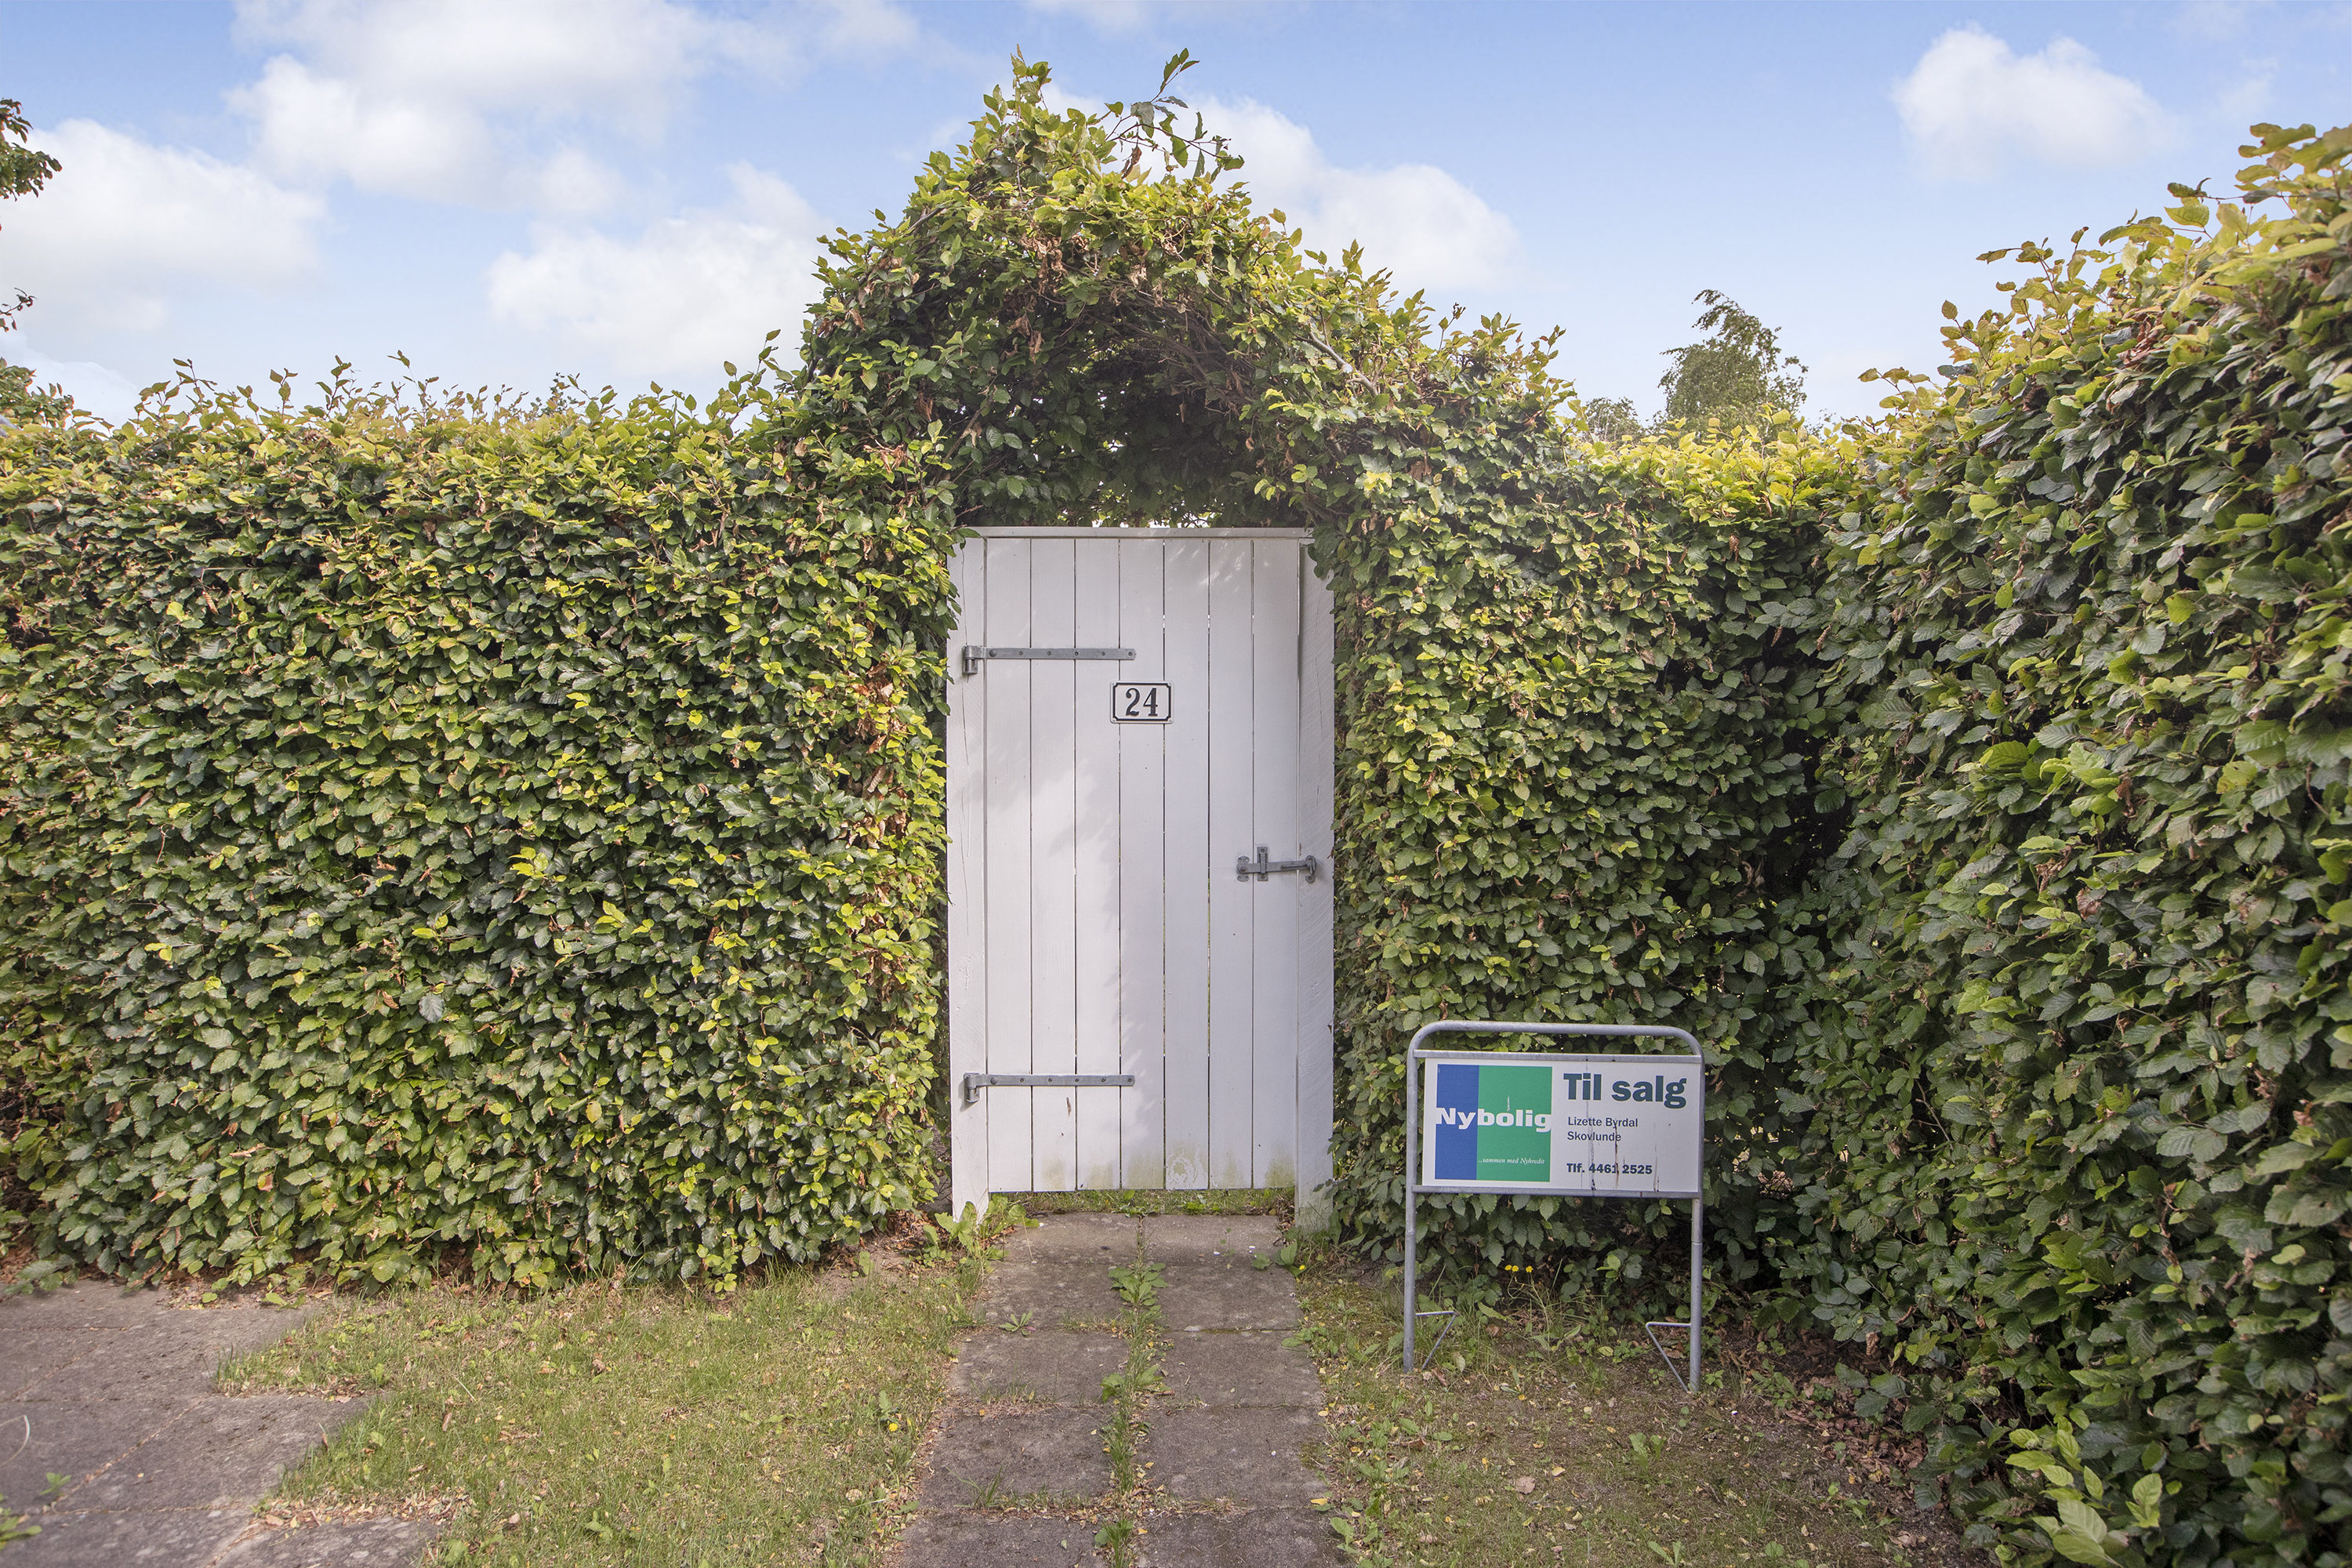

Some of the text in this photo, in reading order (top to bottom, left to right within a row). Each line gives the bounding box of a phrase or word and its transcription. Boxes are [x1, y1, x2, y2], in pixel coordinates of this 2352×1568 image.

[1126, 688, 1158, 717] 24
[1563, 1073, 1687, 1109] Til salg
[1436, 1107, 1552, 1133] Nybolig
[1568, 1116, 1638, 1129] Lizette Byrdal
[1567, 1131, 1621, 1142] Skovlunde
[1566, 1163, 1653, 1174] Tlf. 4461 2525
